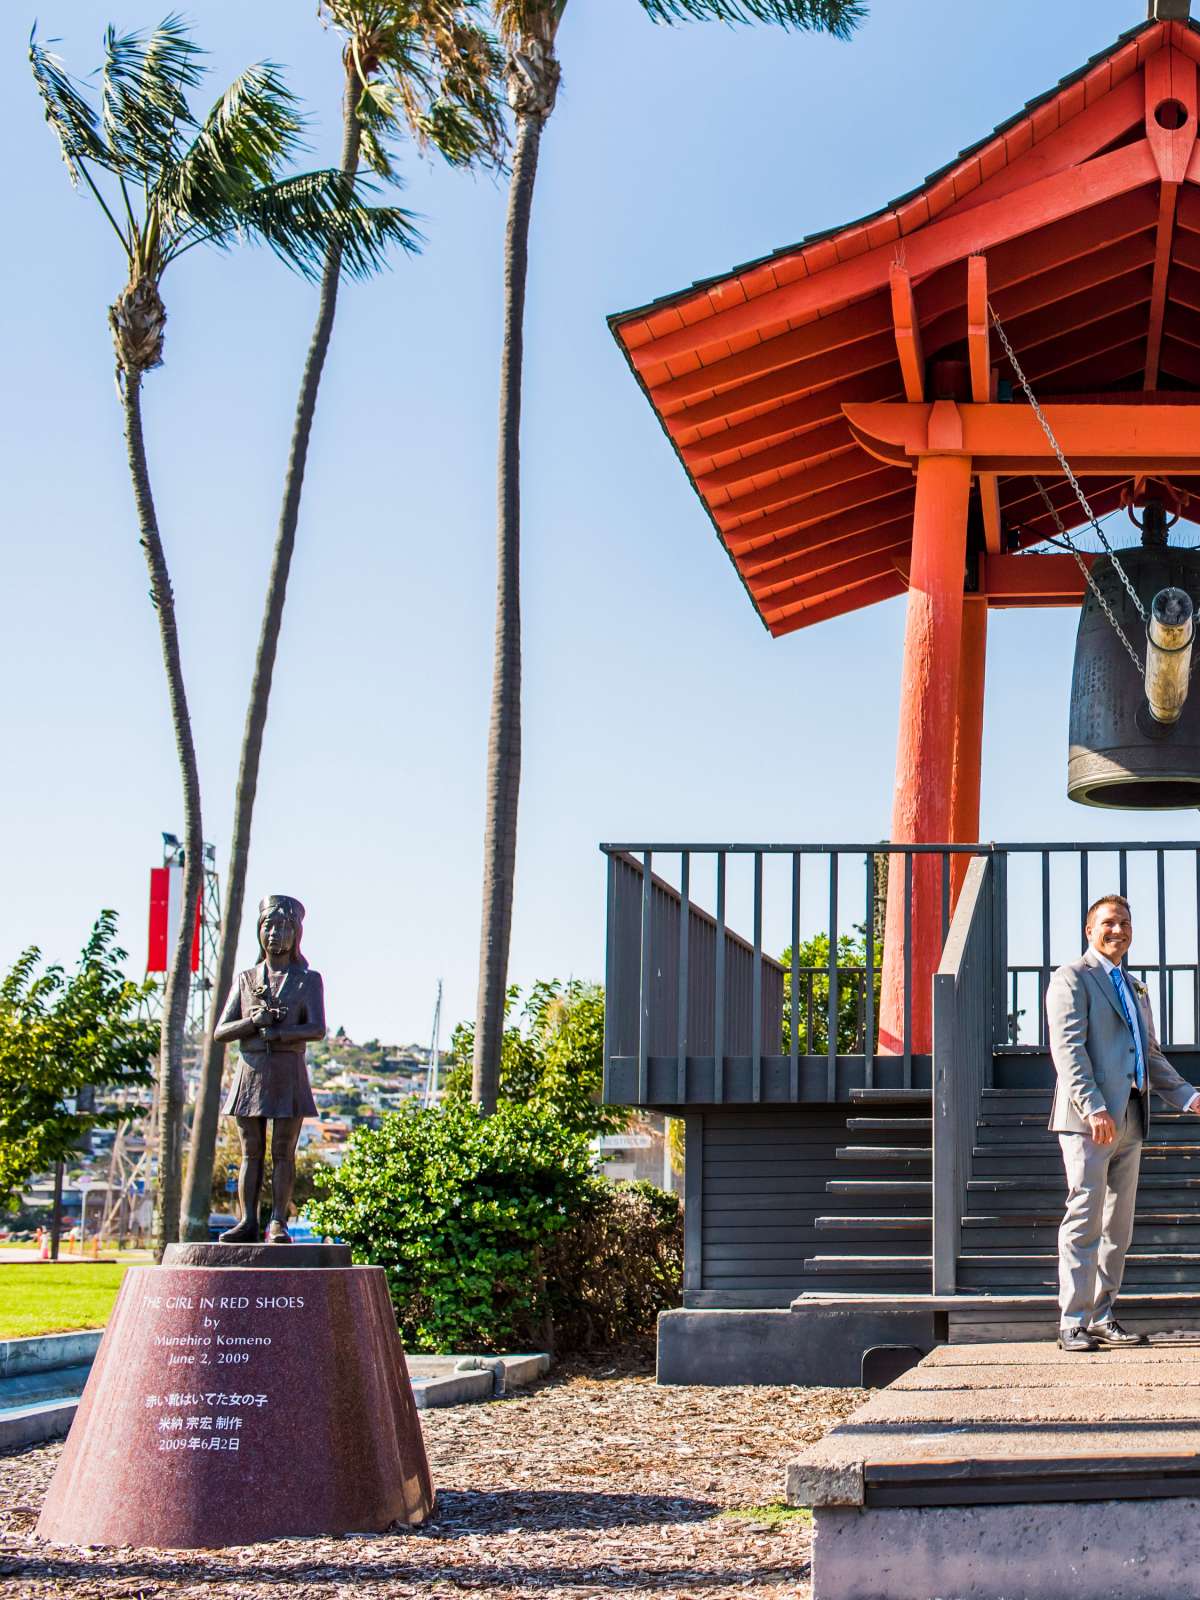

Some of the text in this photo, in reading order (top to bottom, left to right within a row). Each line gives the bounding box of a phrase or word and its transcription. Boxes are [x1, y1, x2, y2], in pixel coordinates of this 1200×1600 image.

[143, 1297, 305, 1309] THE GIRL IN RED SHOES
[203, 1316, 220, 1330] by
[155, 1335, 272, 1346] Munehiro Komeno
[168, 1353, 249, 1366] June 2, 2009
[145, 1392, 268, 1408] 赤い靴はいてた女の子
[159, 1437, 240, 1450] 2009年6月2日
